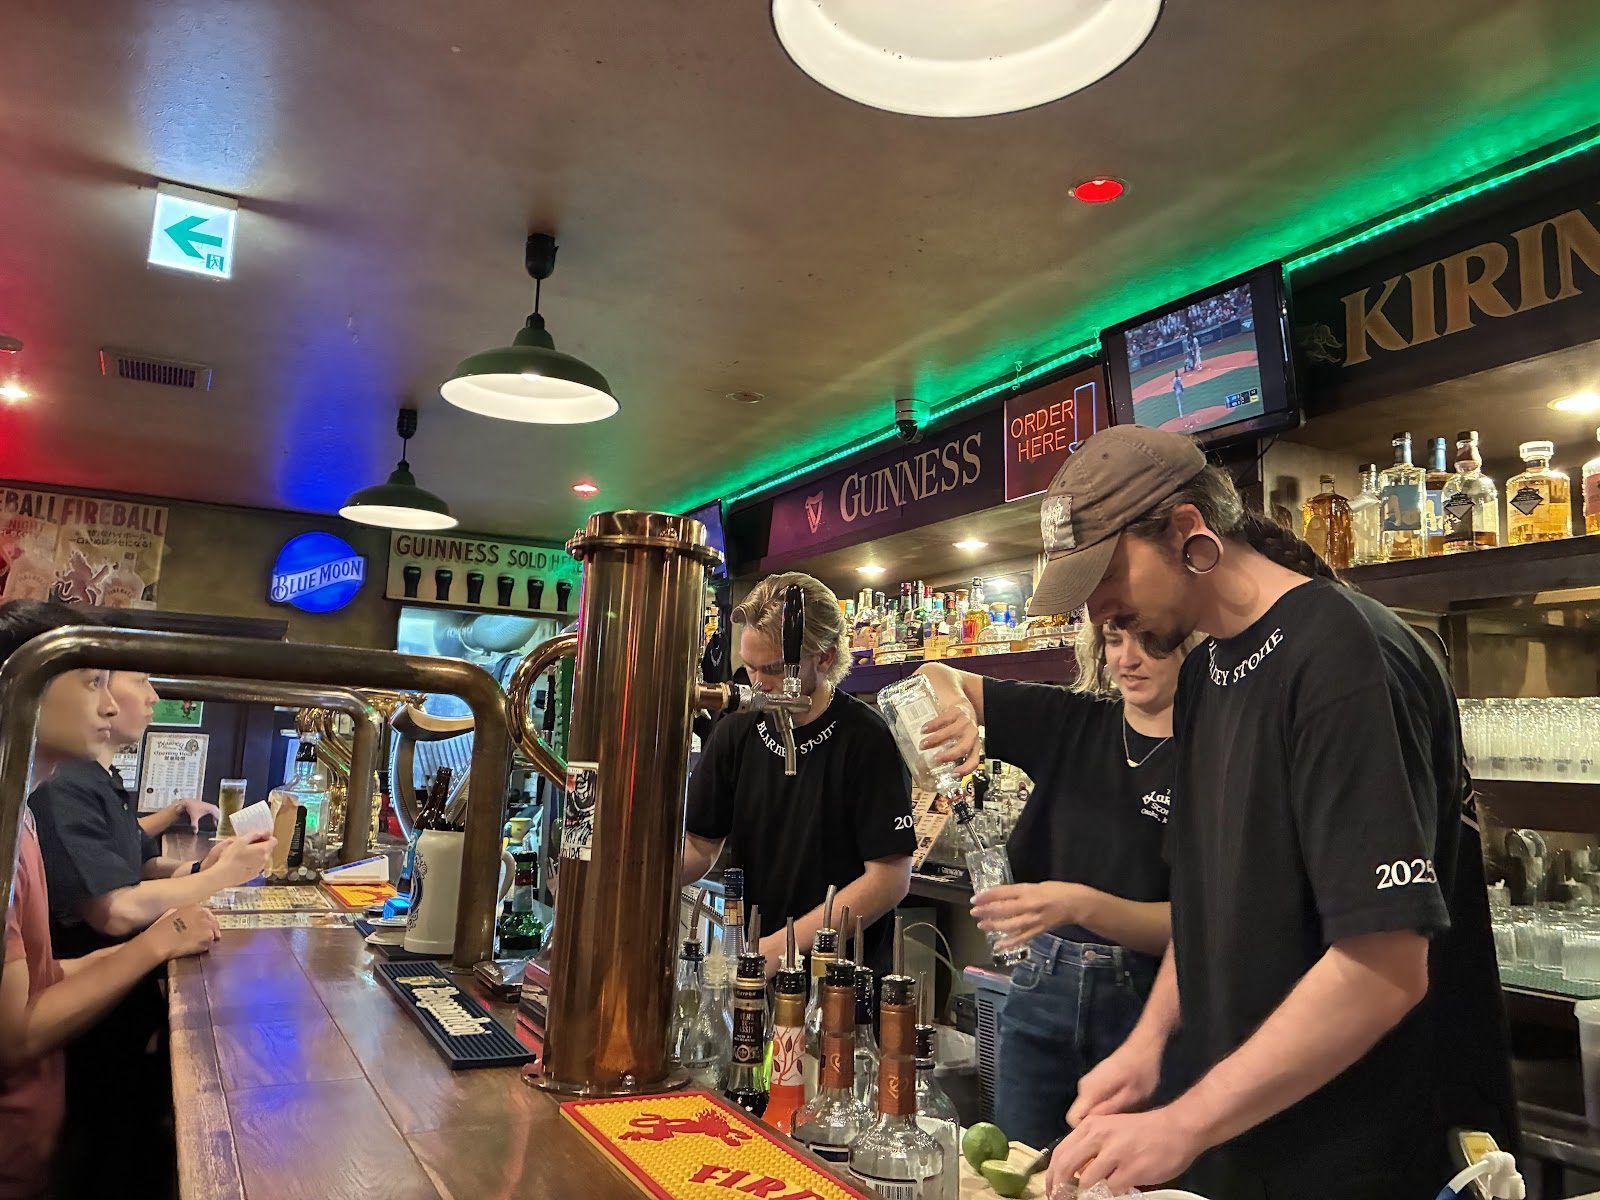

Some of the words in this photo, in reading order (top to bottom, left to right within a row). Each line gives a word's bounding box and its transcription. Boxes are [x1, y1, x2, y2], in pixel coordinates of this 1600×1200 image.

[1011, 399, 1074, 438] ORDER
[1018, 427, 1066, 462] HERE
[840, 432, 982, 522] GUINNESS
[0, 490, 57, 524] BALL
[61, 498, 164, 536] FIREBALL
[397, 535, 499, 564] GUINNESS
[508, 549, 547, 569] SOLD
[272, 574, 317, 601] BLUE
[320, 560, 363, 585] MOON
[1375, 859, 1437, 889] 2025
